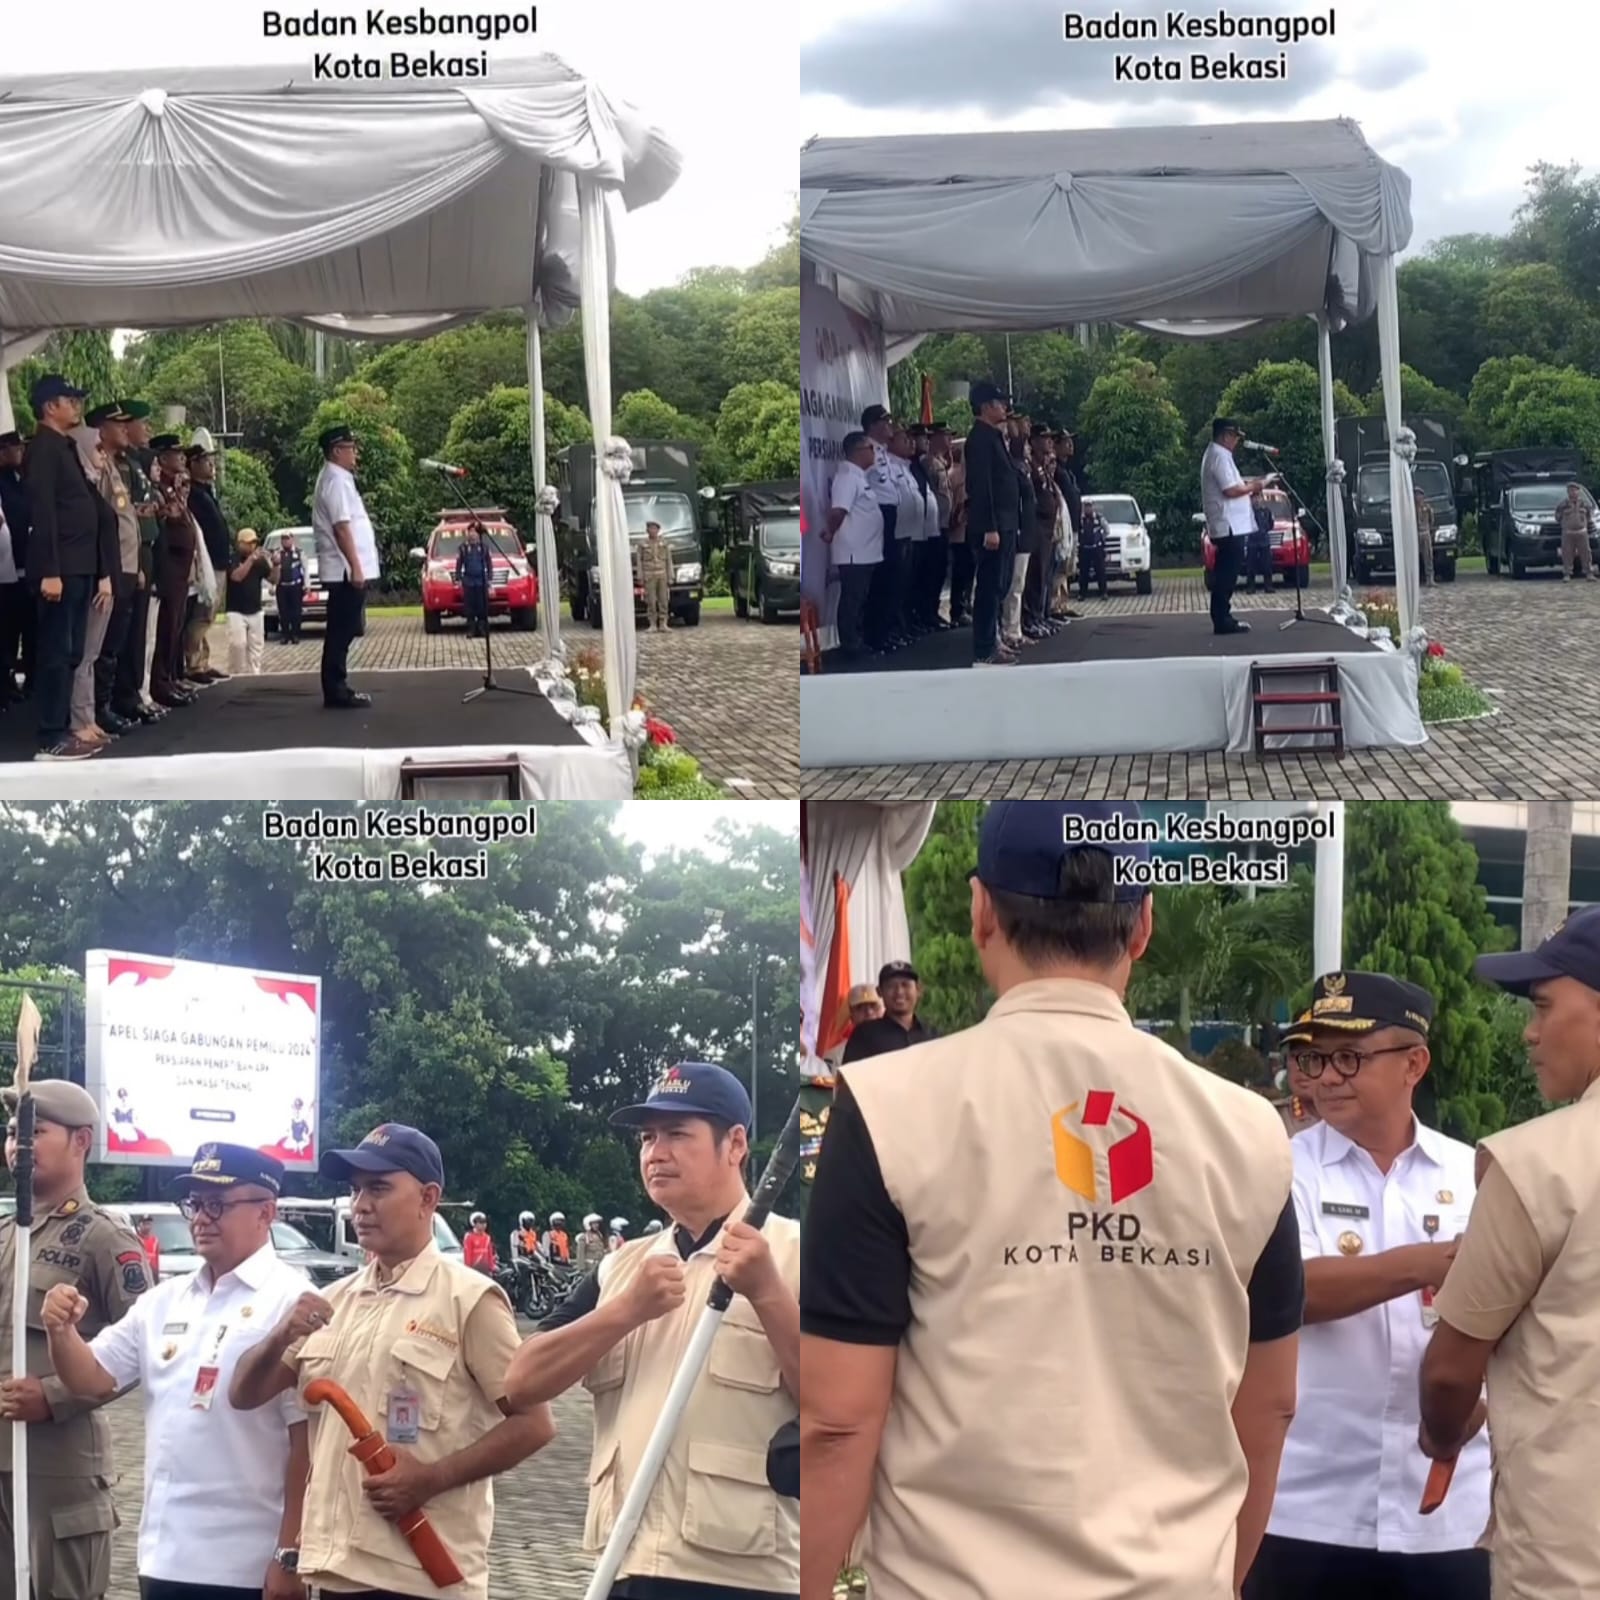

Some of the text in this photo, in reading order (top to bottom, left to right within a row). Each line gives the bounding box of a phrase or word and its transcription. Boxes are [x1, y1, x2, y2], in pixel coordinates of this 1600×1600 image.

[109, 1024, 139, 1040] APEL
[142, 1027, 178, 1044] SIAGA
[180, 1032, 243, 1050] GABUNGAN
[1068, 1212, 1141, 1242] PKD
[1004, 1245, 1210, 1266] KOTA BEKASI
